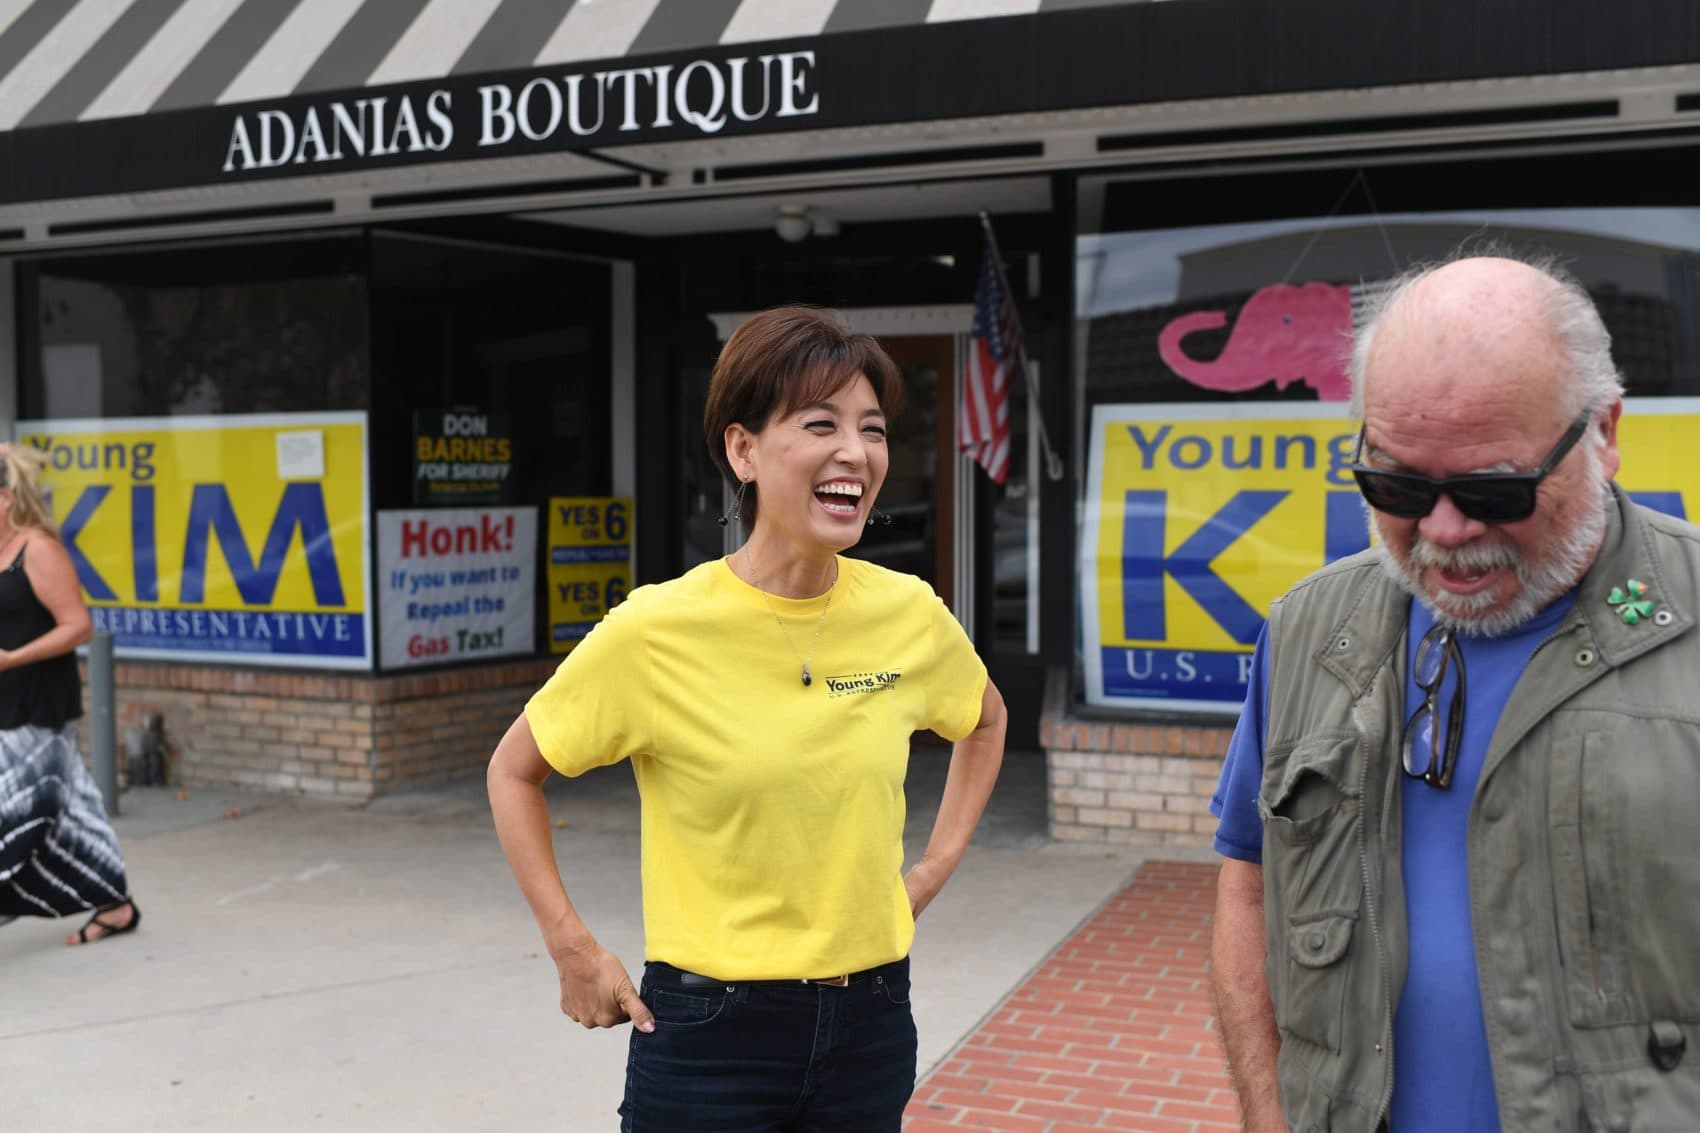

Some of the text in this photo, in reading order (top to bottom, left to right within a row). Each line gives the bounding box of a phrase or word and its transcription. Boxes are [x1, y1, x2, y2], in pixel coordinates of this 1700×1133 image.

[222, 50, 820, 172] ADANIAS BOUTIQUE
[443, 413, 487, 435] DON
[417, 436, 512, 462] BARNES
[417, 463, 511, 481] FOR SHERIFF
[401, 514, 515, 558] Honk!
[559, 505, 600, 526] YES
[605, 502, 628, 541] 6
[391, 565, 520, 595] If you want to
[558, 581, 600, 603] YES
[92, 607, 352, 641] REPRESENTATIVE
[407, 595, 504, 623] Repeal the
[407, 627, 504, 659] Gas Tax!
[826, 679, 874, 692] Young
[876, 672, 901, 683] Kim
[1125, 650, 1214, 684] U.S.
